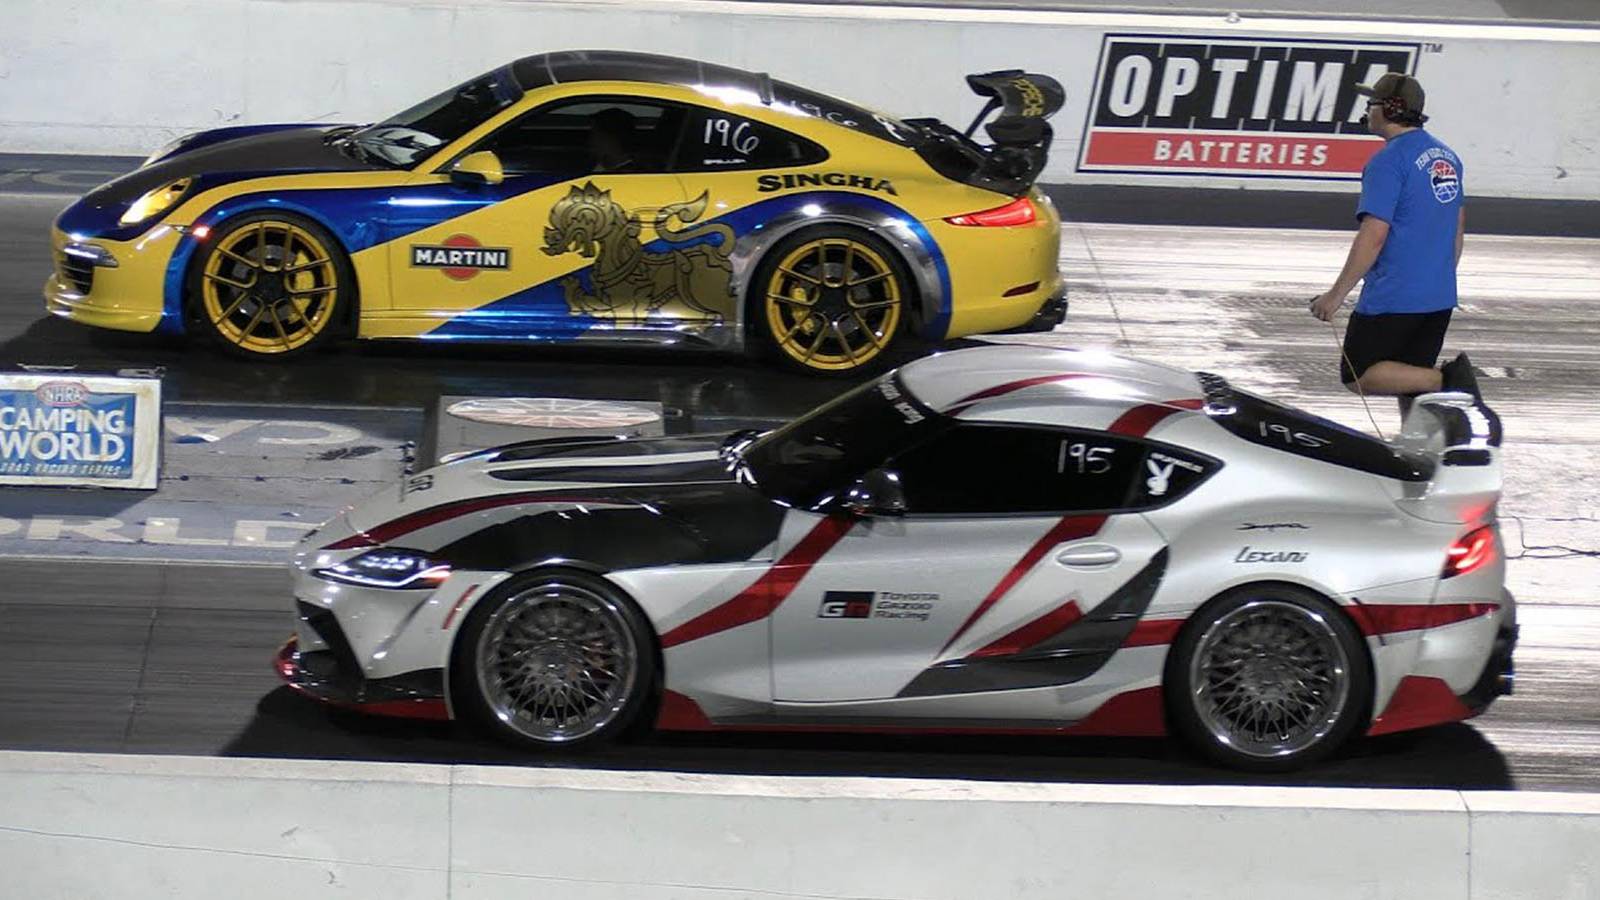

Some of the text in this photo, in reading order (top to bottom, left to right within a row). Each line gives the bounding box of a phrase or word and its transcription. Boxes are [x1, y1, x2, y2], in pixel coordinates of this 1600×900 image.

[703, 119, 760, 155] 196
[1153, 139, 1330, 166] BATTERIES
[757, 173, 898, 196] SINGHA
[415, 249, 507, 266] MARTINI
[44, 385, 81, 402] NHRA
[0, 406, 126, 434] CAMPING
[0, 431, 126, 462] WORLD
[1259, 420, 1332, 448] 195
[1057, 439, 1116, 474] 195
[879, 591, 940, 601] TOYOTA
